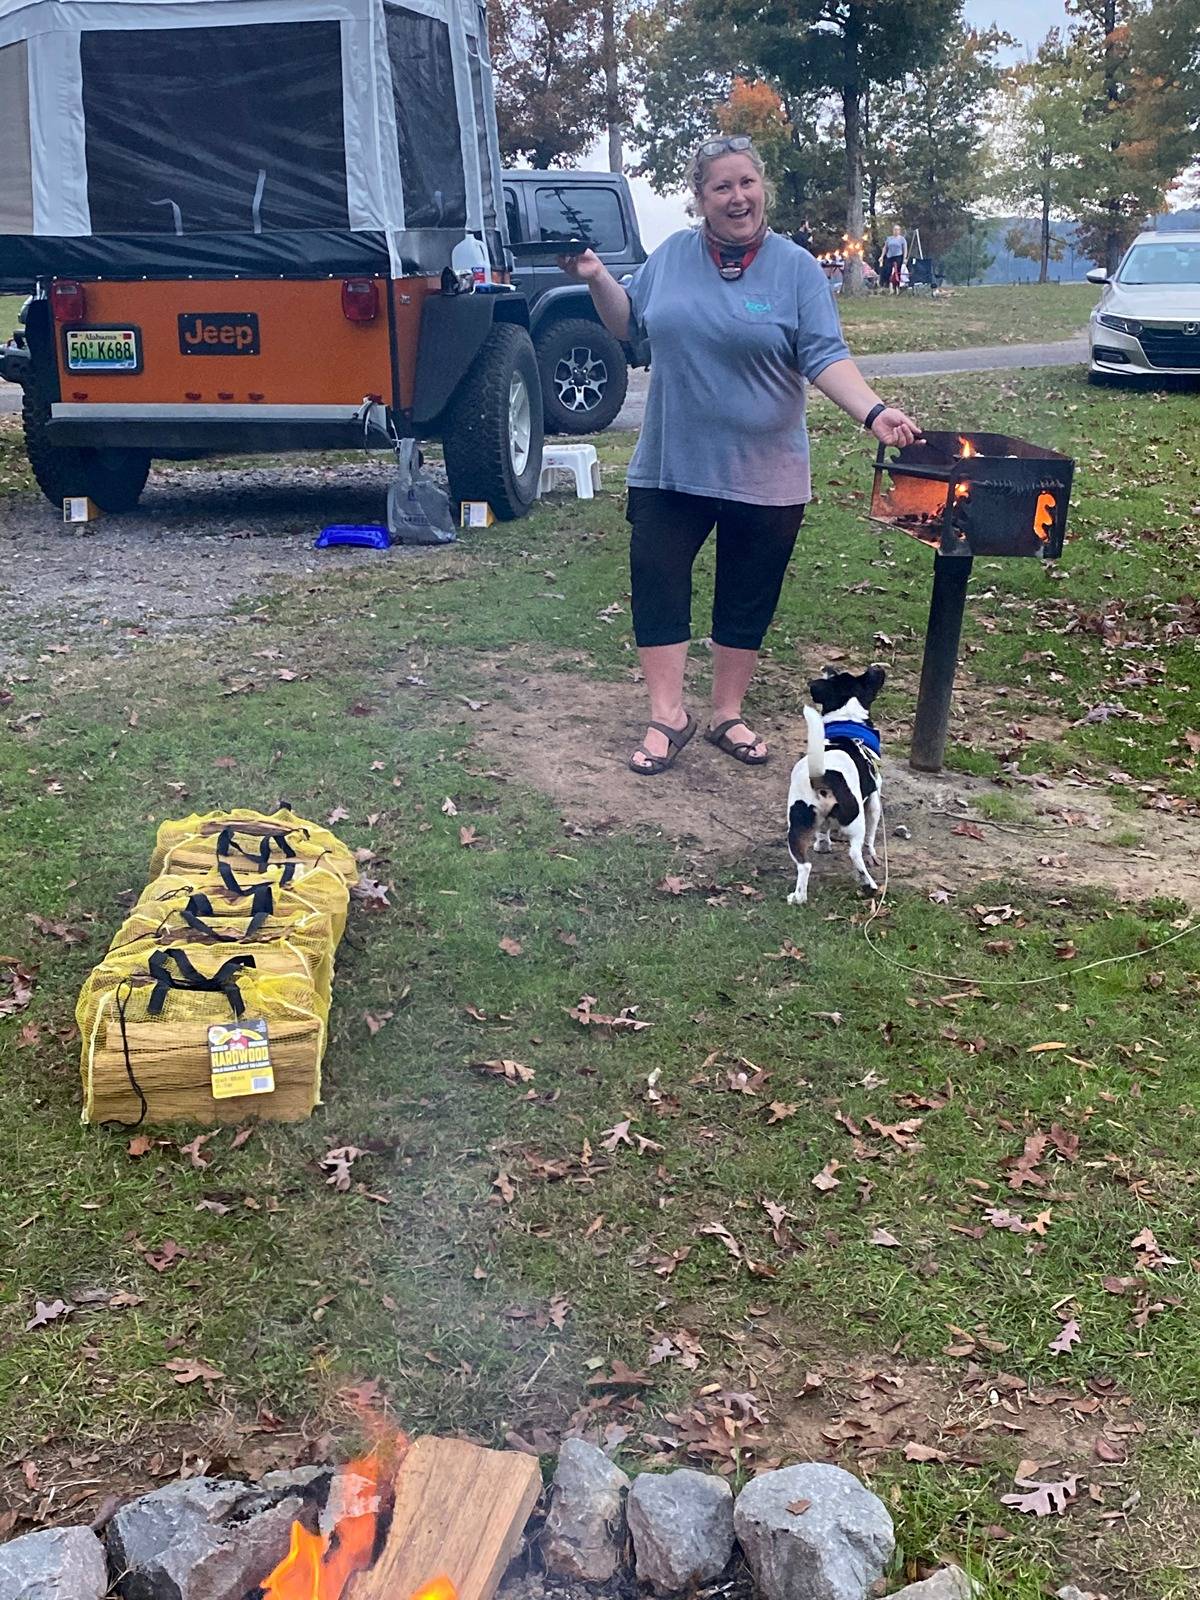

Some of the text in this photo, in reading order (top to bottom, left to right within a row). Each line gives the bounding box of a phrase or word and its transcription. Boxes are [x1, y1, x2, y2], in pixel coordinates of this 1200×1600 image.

[84, 333, 117, 341] Alabama
[184, 319, 253, 349] Jeep
[71, 342, 88, 360] 50
[211, 1046, 269, 1068] HARDWOOD
